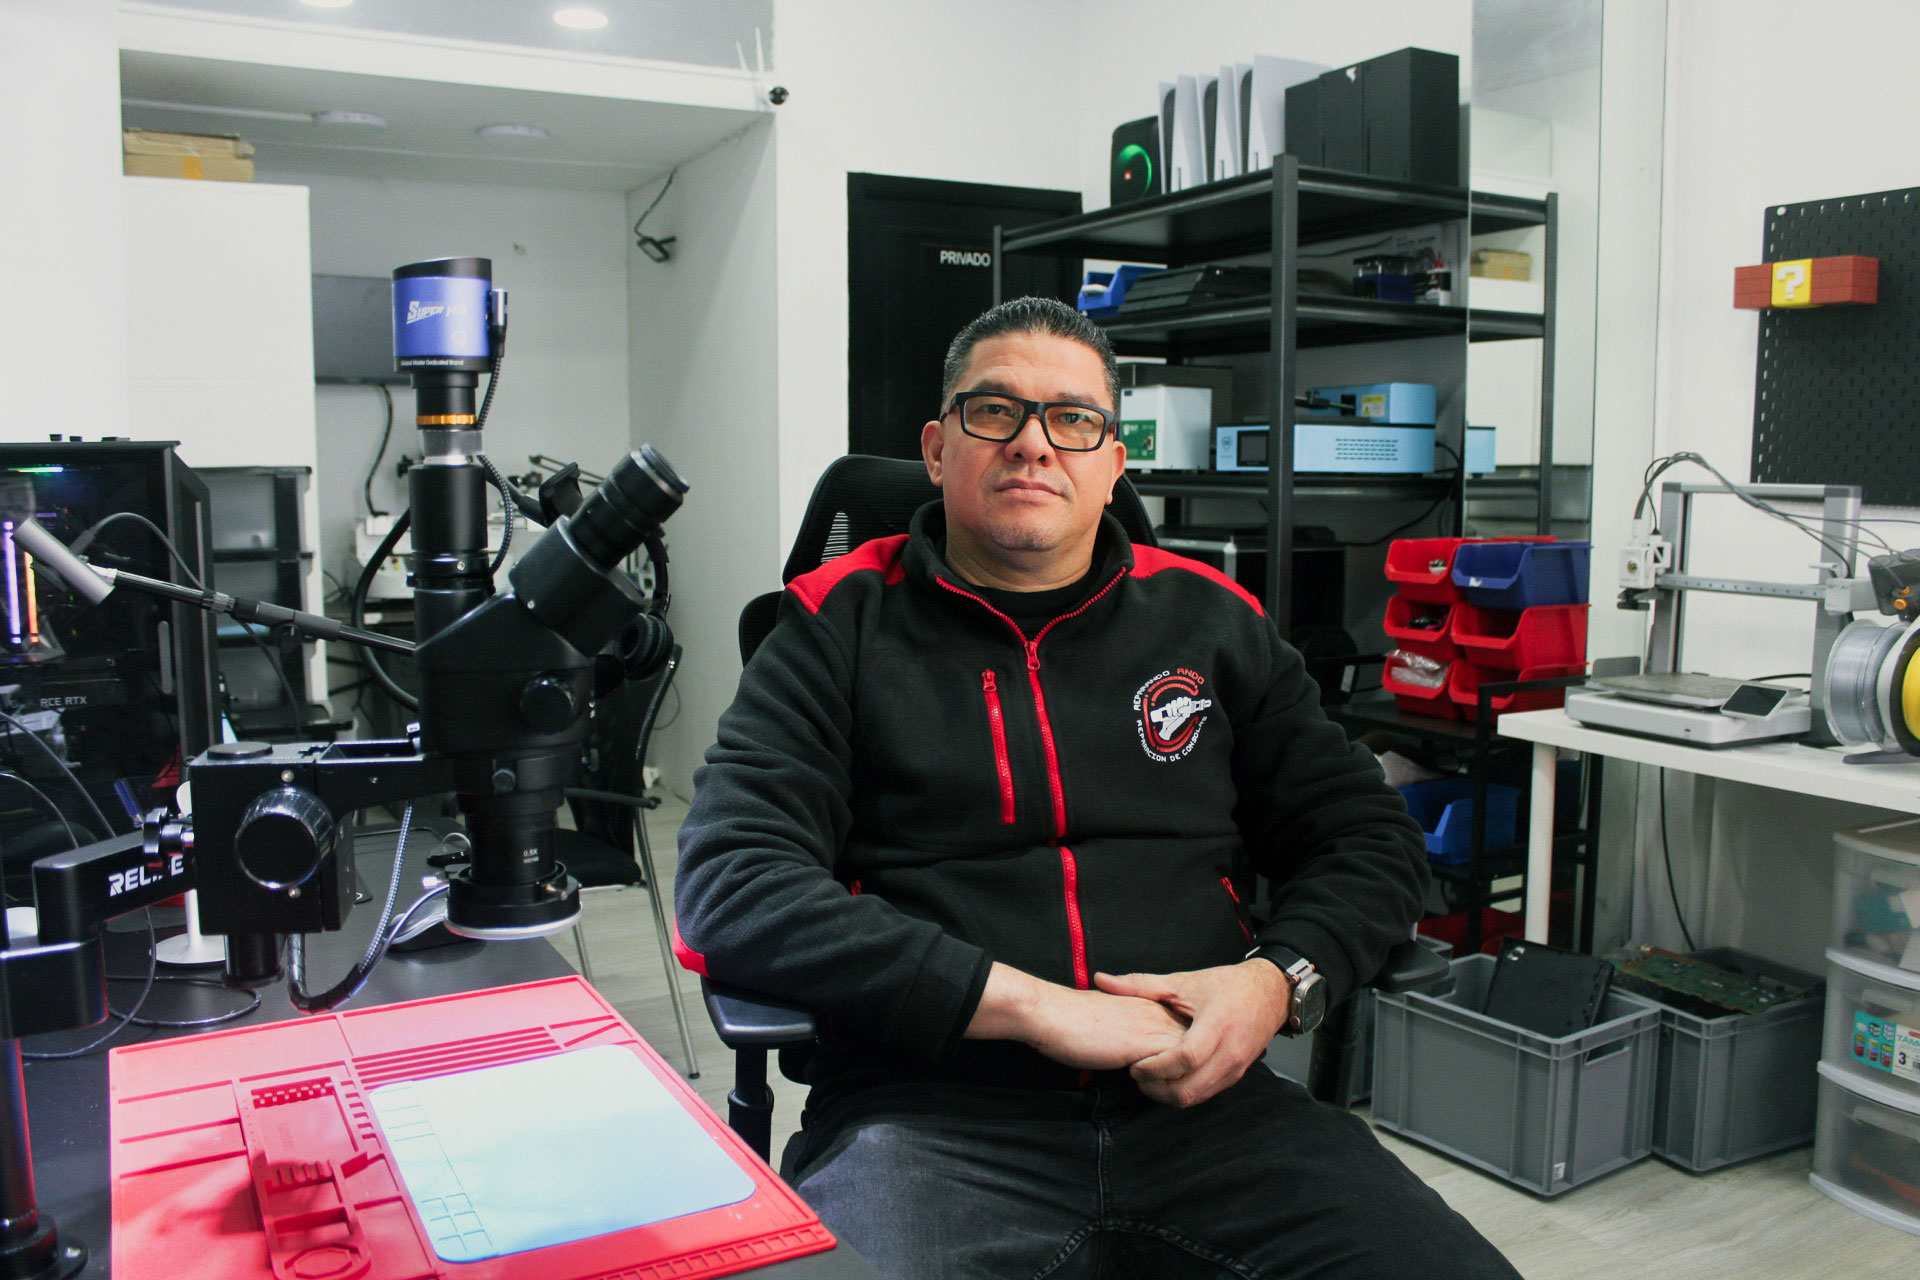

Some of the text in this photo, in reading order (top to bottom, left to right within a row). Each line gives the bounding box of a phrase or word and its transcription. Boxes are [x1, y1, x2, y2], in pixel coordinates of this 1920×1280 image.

[940, 250, 991, 267] PRIVADO
[1776, 265, 1804, 300] ?
[1177, 667, 1205, 685] ANDO
[65, 695, 88, 706] RTX
[1169, 753, 1181, 762] DE
[108, 854, 184, 897] RELE
[1898, 1034, 1920, 1048] TAM
[1898, 1051, 1907, 1066] 3
